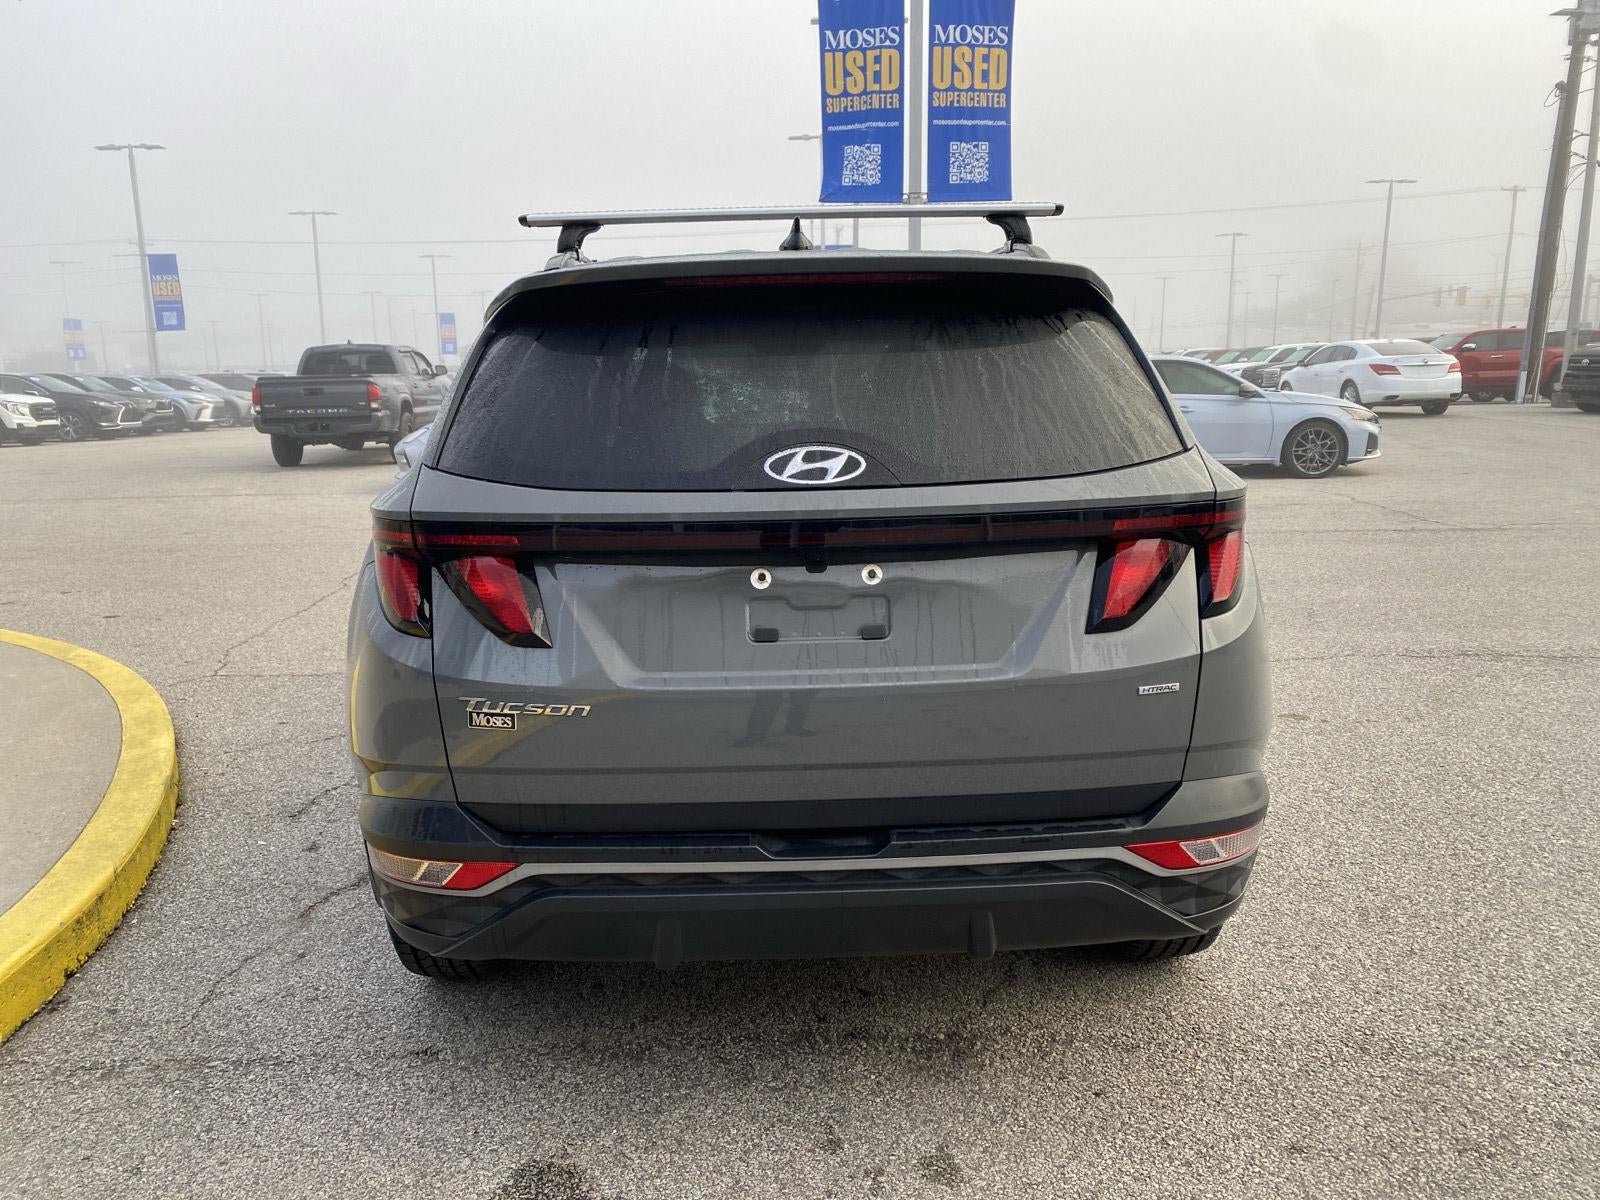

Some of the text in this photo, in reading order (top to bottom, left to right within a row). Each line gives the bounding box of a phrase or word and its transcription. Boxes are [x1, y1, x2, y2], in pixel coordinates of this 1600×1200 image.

[824, 25, 900, 50] MOSES
[934, 24, 1009, 46] MOSES
[824, 48, 900, 96] USED
[932, 46, 1008, 90] USED
[826, 93, 900, 114] SUPERCENTER
[932, 91, 1007, 108] SUPERCENTER
[152, 281, 181, 297] USED
[1142, 684, 1177, 693] HTRAC
